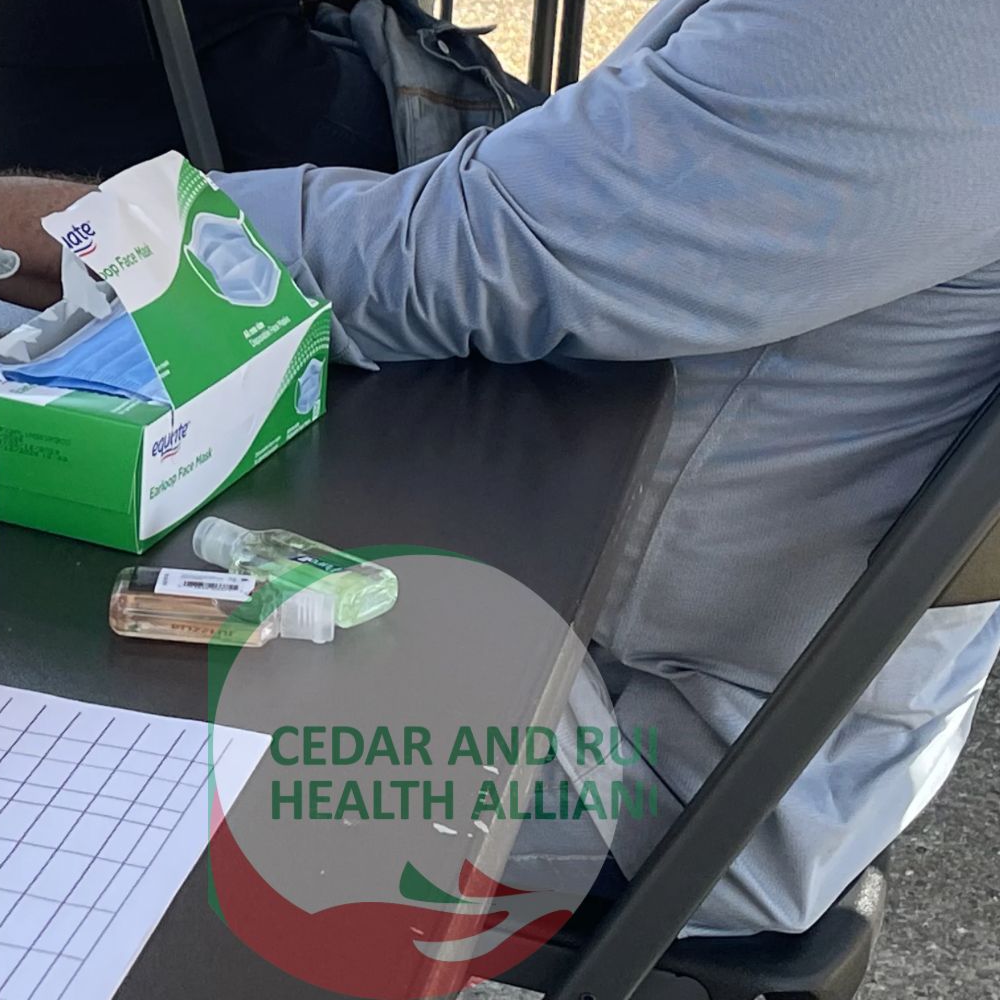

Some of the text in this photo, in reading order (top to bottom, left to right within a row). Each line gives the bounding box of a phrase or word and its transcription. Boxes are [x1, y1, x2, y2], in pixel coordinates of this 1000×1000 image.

[115, 252, 139, 270] Face
[134, 244, 153, 260] Mask
[149, 447, 213, 500] Earloop Face Mask
